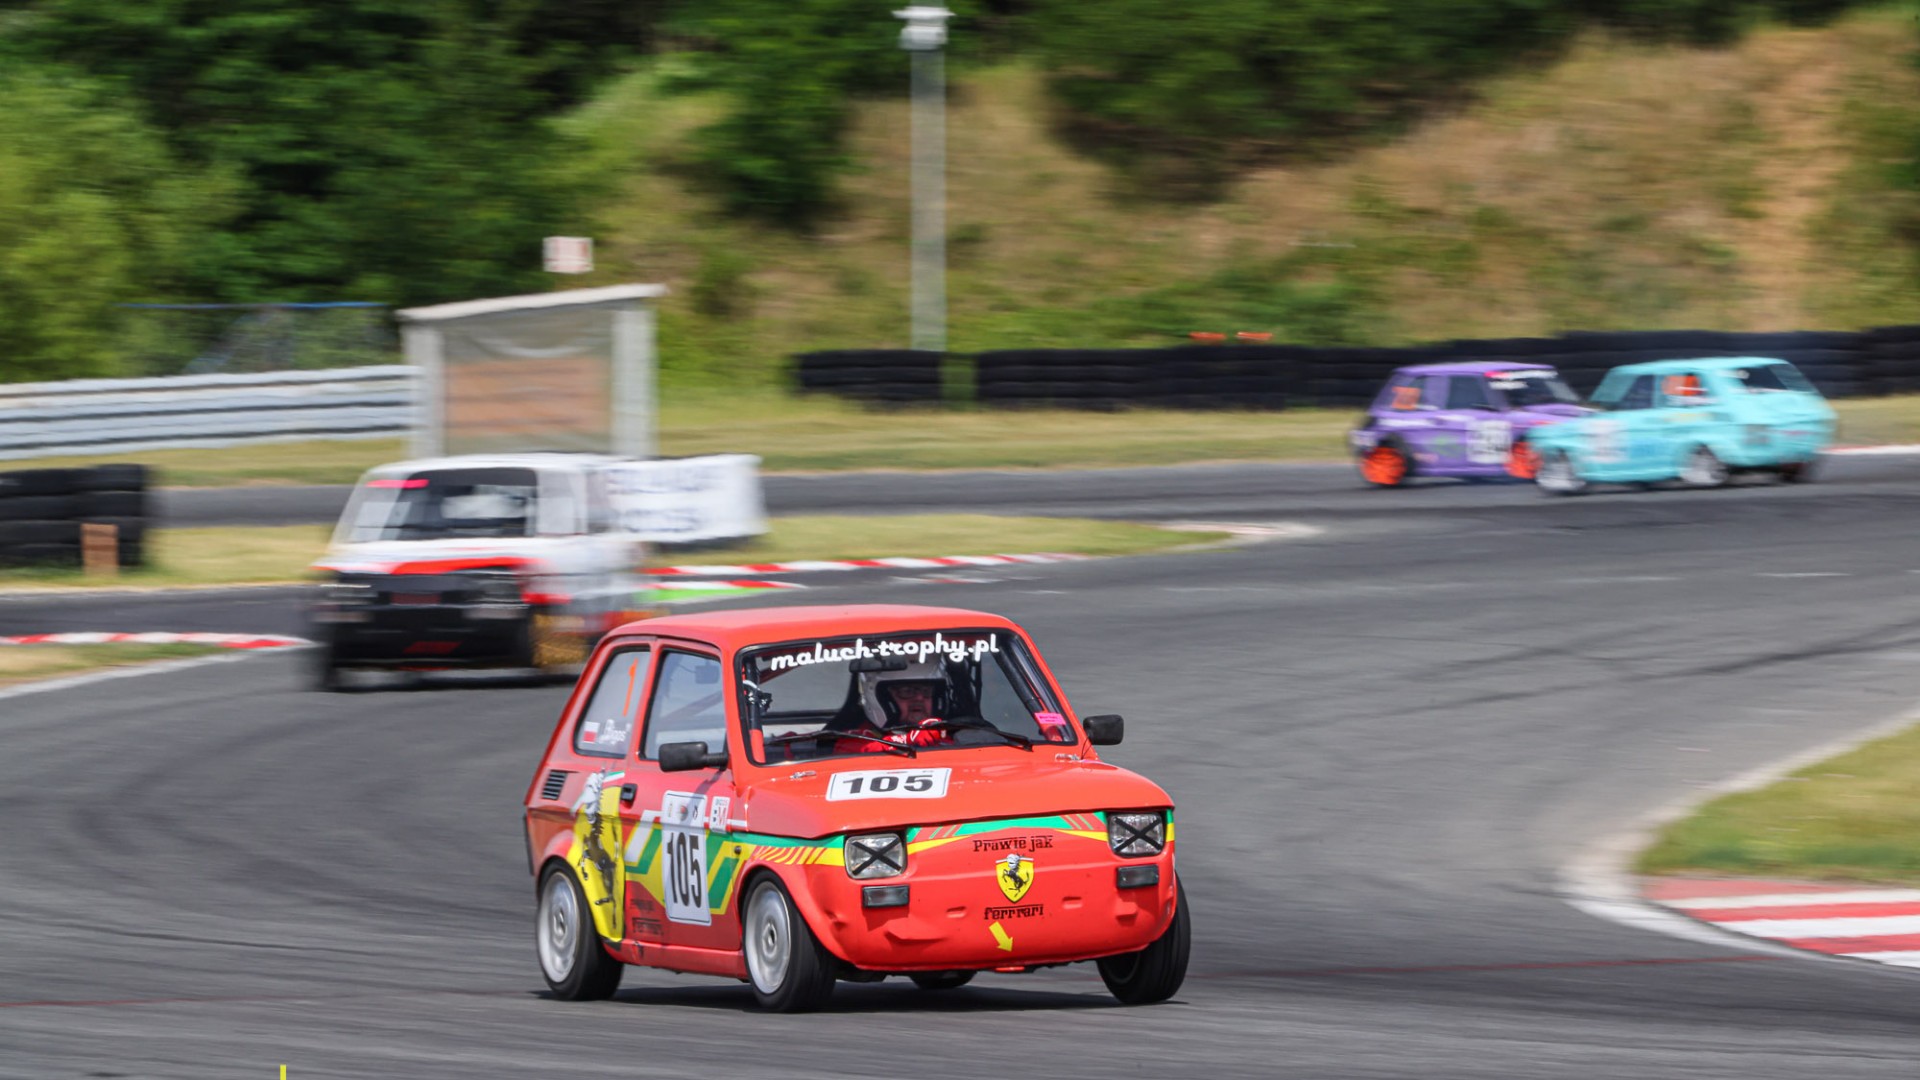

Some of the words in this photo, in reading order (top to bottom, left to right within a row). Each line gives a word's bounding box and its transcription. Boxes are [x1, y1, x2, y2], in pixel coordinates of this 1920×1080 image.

[771, 632, 999, 671] maluch-trophy.pl
[843, 774, 933, 794] 105
[973, 836, 1027, 852] Prawie
[1028, 834, 1053, 853] jak
[667, 831, 702, 908] 105
